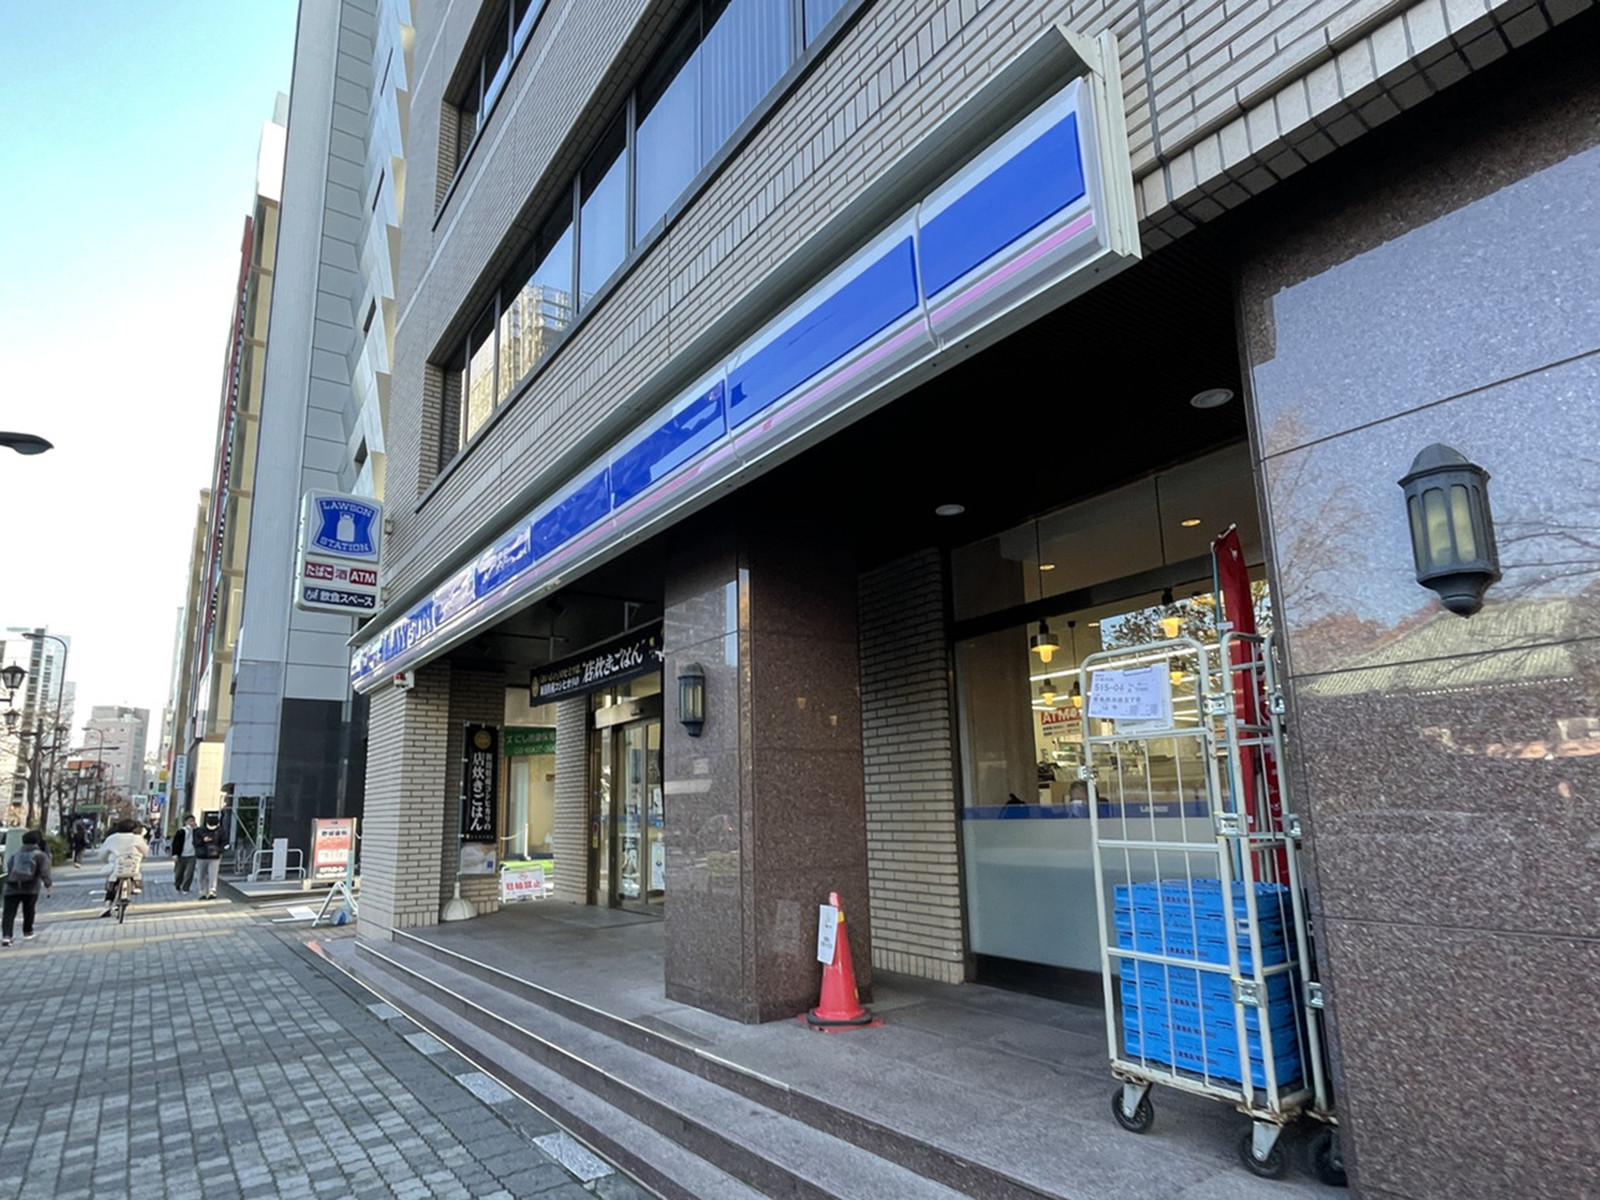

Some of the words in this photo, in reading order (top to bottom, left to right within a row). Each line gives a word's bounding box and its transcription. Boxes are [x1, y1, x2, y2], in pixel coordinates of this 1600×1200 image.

[321, 501, 374, 518] LAWSON
[320, 536, 370, 552] STATION
[306, 563, 333, 579] たばこ
[350, 570, 376, 584] ATM
[320, 592, 373, 606] 飲食スペース
[470, 751, 485, 832] 店炊きごはん
